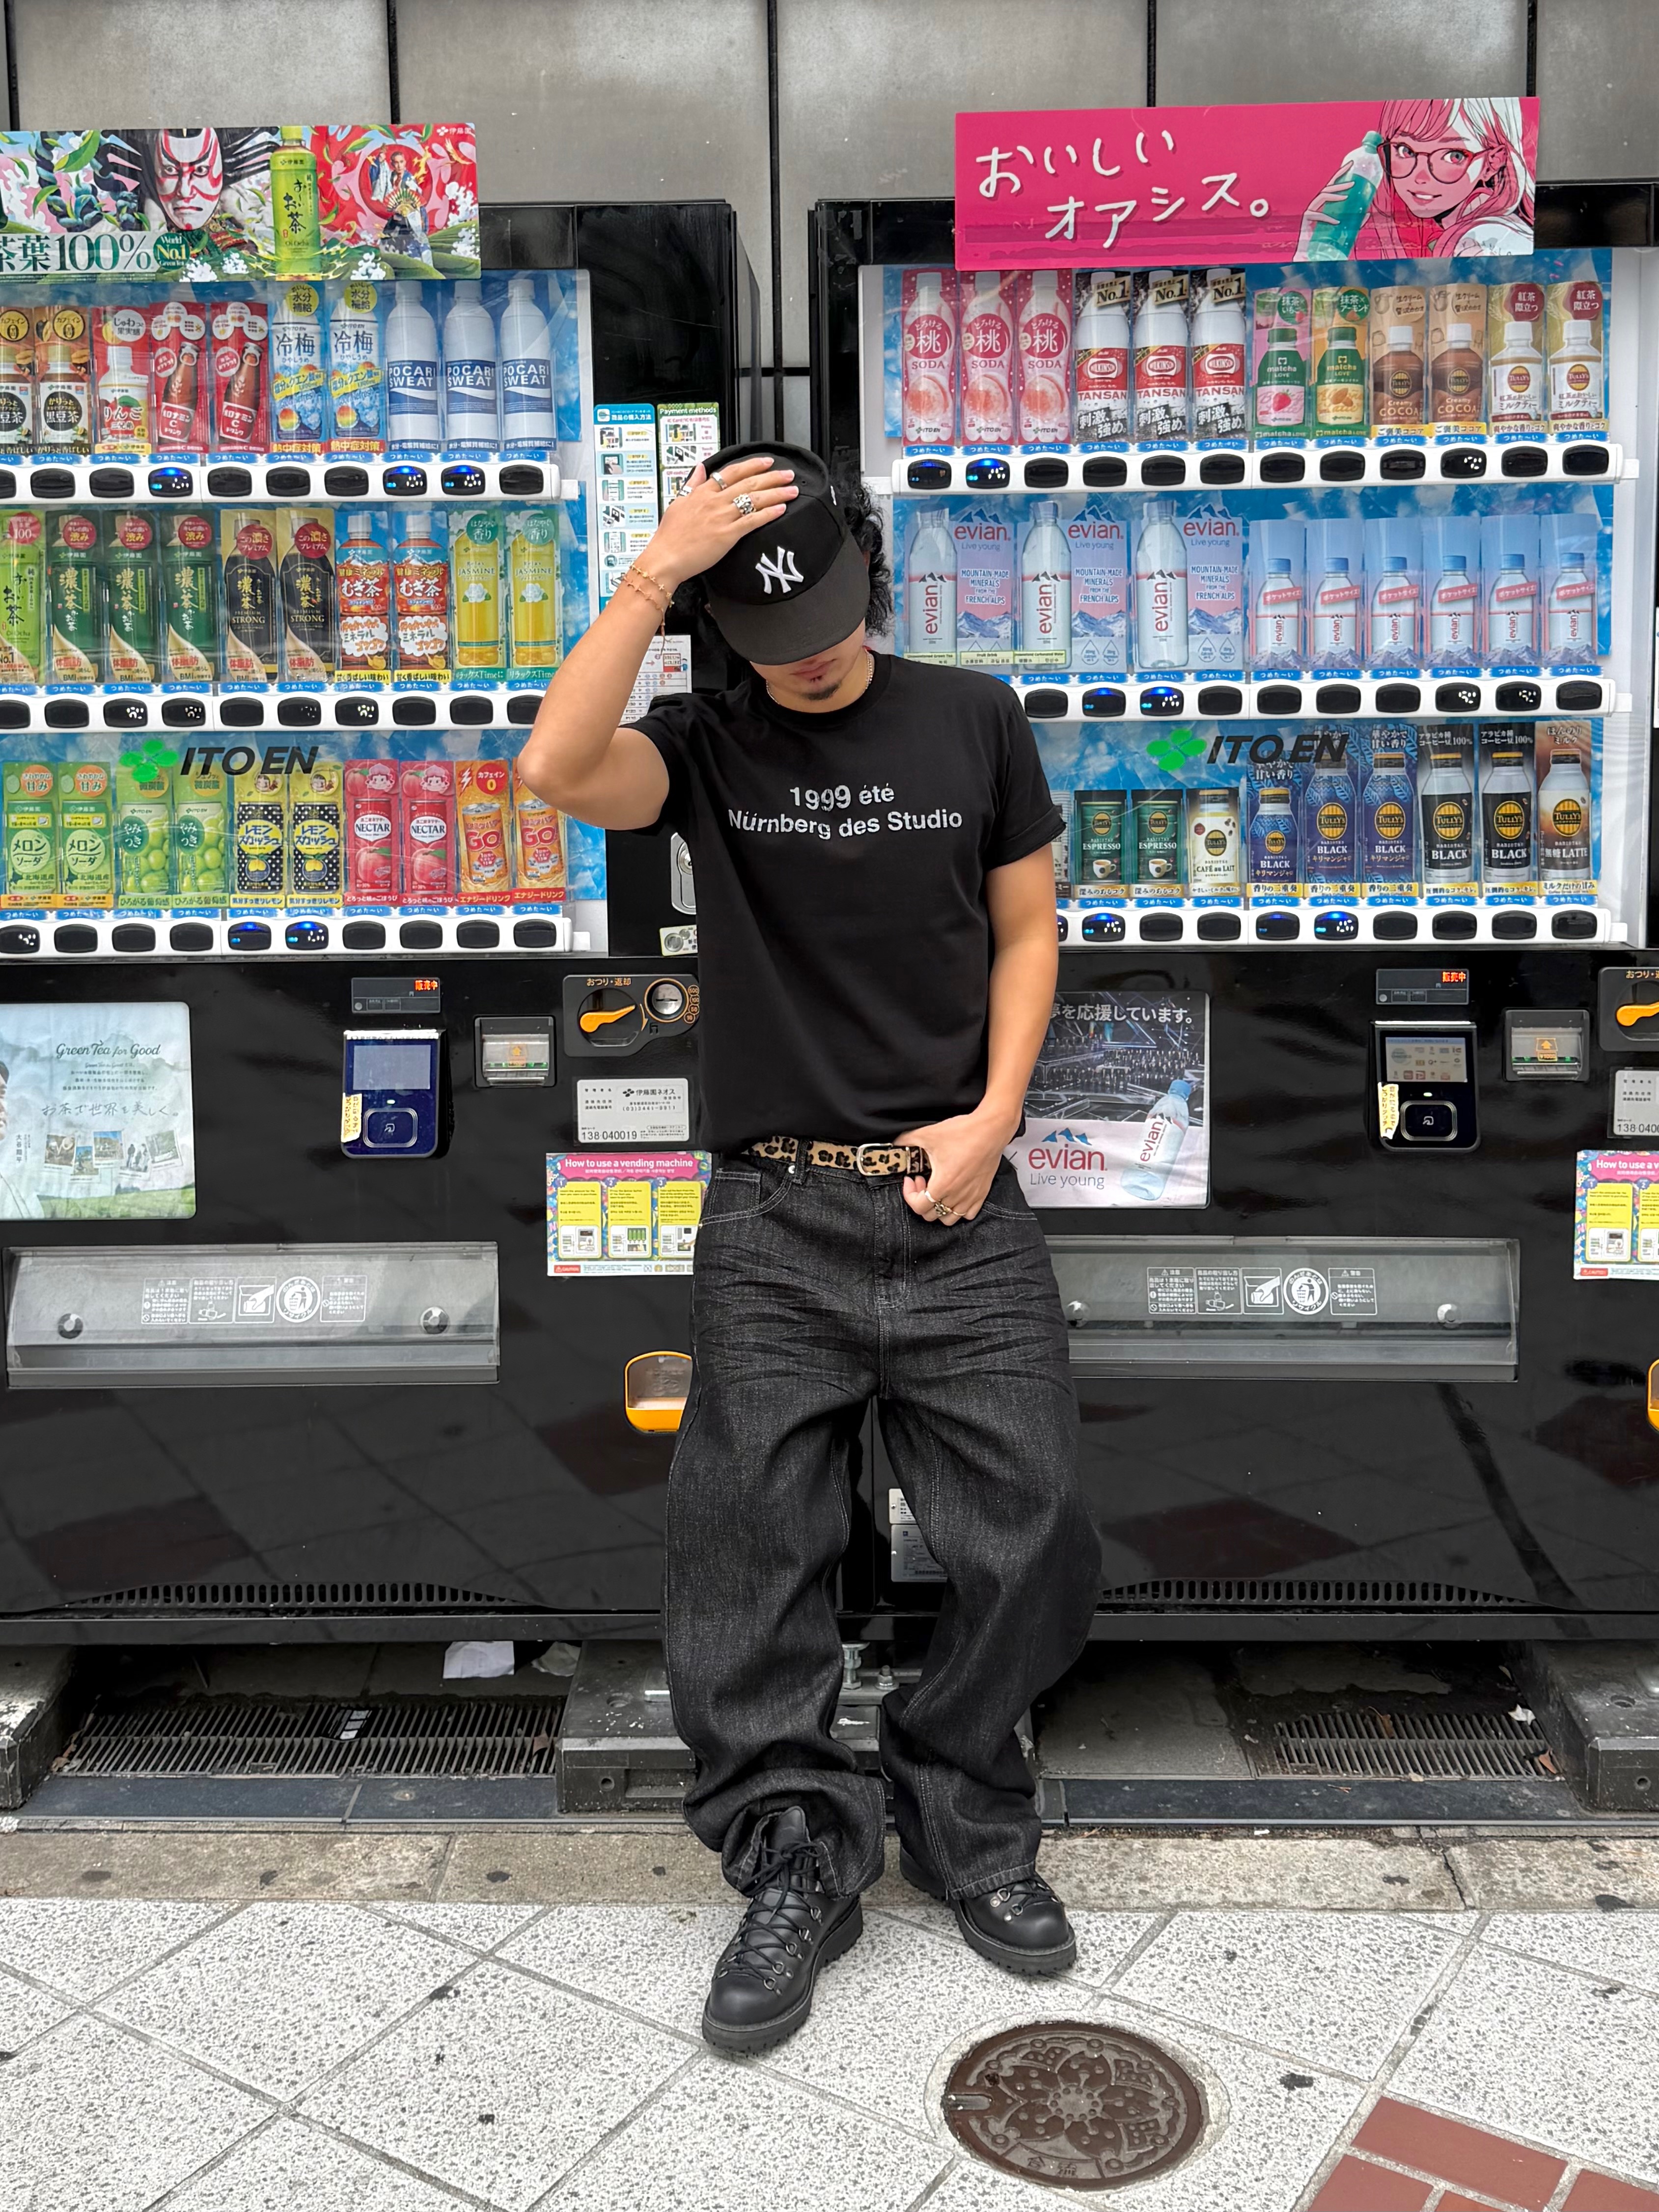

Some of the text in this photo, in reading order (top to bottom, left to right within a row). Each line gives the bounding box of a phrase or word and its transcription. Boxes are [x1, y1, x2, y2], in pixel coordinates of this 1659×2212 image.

[976, 130, 1174, 197] おいしい
[1045, 172, 1269, 249] オアシス。
[156, 244, 189, 259] No.1
[292, 293, 312, 303] 水分
[1518, 292, 1536, 302] 紅茶
[292, 303, 312, 312] 補給
[1340, 304, 1370, 313] アーモンド
[1515, 303, 1538, 312] 際立つ
[54, 317, 81, 326] カフェイン
[276, 333, 315, 357] 冷梅
[333, 333, 373, 357] 冷梅
[916, 330, 941, 353] 桃
[976, 330, 1001, 353] 桃
[912, 361, 944, 369] SODA
[971, 360, 1004, 369] SODA
[389, 366, 437, 377] POCARI
[447, 366, 494, 377] POCARI
[389, 377, 433, 387] SWEAT
[447, 377, 492, 387] SWEAT
[1078, 391, 1127, 401] TANSAN
[1438, 405, 1477, 414] COCOA
[1499, 401, 1538, 411] ミルクティー
[46, 411, 78, 423] 黒豆茶
[104, 406, 142, 422] りんご
[1379, 407, 1419, 417] COCOA
[1158, 419, 1186, 435] 強め。
[1377, 427, 1424, 435] ご褒美ココア
[1493, 423, 1545, 432] 爽やかな香りとコク
[240, 531, 269, 544] この濃さ
[473, 528, 492, 539] 香り
[458, 567, 496, 575] JASMINE
[755, 546, 804, 593] NY
[961, 569, 1009, 579] MOUNTAIN-MADE
[341, 578, 383, 598] むぎ茶
[399, 577, 442, 598] むぎ茶
[970, 579, 1000, 588] MINERALS
[59, 567, 82, 611] 濃い茶
[116, 567, 139, 611] 濃い茶
[965, 595, 1005, 605] FRENCH ALPS
[926, 584, 938, 635] evian
[1039, 584, 1053, 634] evian
[231, 616, 265, 624] STRONG
[290, 615, 325, 623] STRONG
[343, 629, 376, 642] ミネラル
[336, 672, 389, 682] 甘く香ばしい味わい
[1547, 727, 1582, 735] ほんのり
[1372, 740, 1407, 749] 甘い香り
[1452, 737, 1472, 745] 100%
[1206, 735, 1350, 764] ITO EN
[180, 746, 319, 776] ITO EN
[26, 781, 48, 791] 甘み
[487, 781, 494, 791] 0
[790, 783, 894, 811] 1999 été
[355, 822, 390, 834] NECTAR
[839, 816, 880, 837] des
[887, 809, 963, 831] Studio
[244, 826, 272, 836] レモン
[411, 824, 445, 834] NECTAR
[125, 836, 141, 848] つき
[238, 834, 282, 845] スカッシュ
[12, 839, 47, 853] メロン
[68, 838, 102, 853] メロン
[1317, 845, 1348, 854] BLACK
[1544, 848, 1588, 858] 無糖 LATTE
[16, 856, 43, 868] ソーダ
[71, 856, 98, 867] ソーダ
[26, 874, 55, 883] 北海道産
[1253, 885, 1298, 893] 香りの三重奏
[460, 894, 511, 903] エナジードリンク
[514, 890, 565, 899] エナジードリンク
[415, 980, 438, 991] 販売中
[586, 978, 632, 987] おつり・返却
[56, 1040, 161, 1059] Green Tea for Good
[565, 1159, 585, 1167] How
[620, 1159, 655, 1169] vending
[656, 1159, 692, 1167] machine
[1596, 1160, 1617, 1169] How
[1030, 1173, 1105, 1189] Live young
